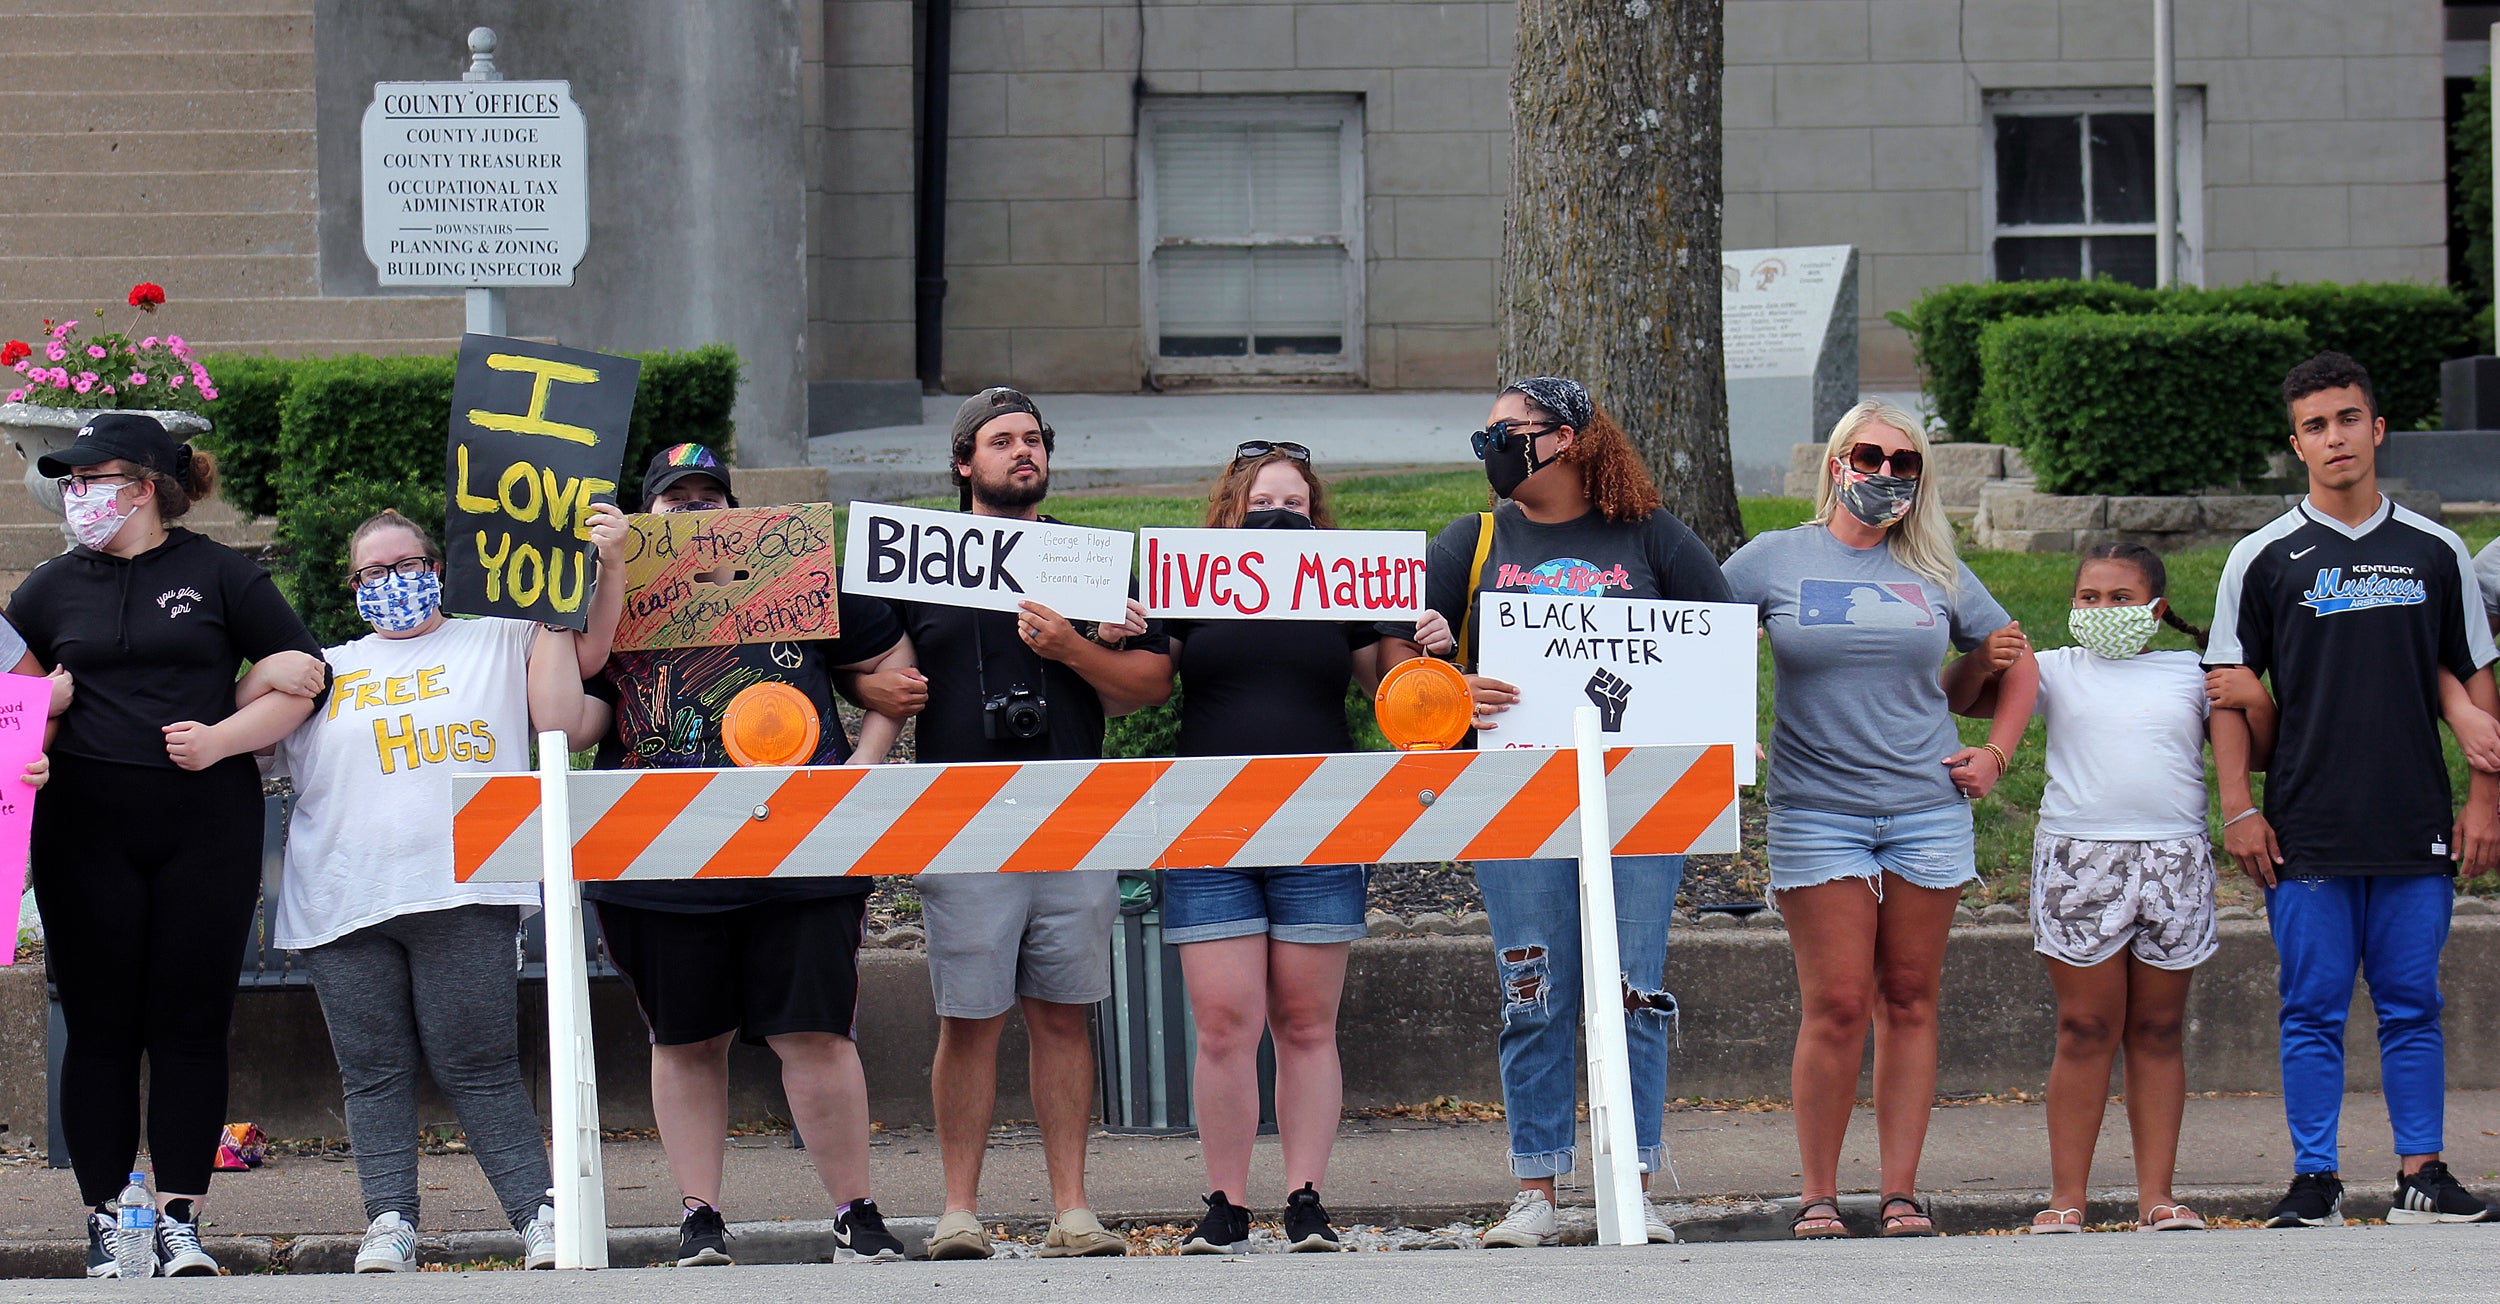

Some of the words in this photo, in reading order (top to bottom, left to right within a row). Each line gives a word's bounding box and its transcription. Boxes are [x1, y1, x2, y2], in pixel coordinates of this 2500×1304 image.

[384, 94, 467, 114] COUNTY
[475, 94, 559, 113] OFFICES
[406, 129, 477, 143] COUNTY
[481, 129, 538, 143] JUDGE
[383, 154, 453, 168] COUNTY
[458, 154, 562, 168] TREASURER
[388, 180, 520, 194] OCCUPATIONAL
[524, 181, 558, 194] TAX
[402, 199, 545, 212] ADMINISTRATOR
[435, 224, 513, 235] DOWNSTAIRS
[390, 240, 473, 254] PLANNING
[478, 241, 490, 254] &
[495, 240, 559, 254] ZONING
[388, 262, 465, 276] BUILDING
[471, 262, 562, 276] INSPECTOR
[466, 353, 600, 447] I
[456, 443, 616, 542] LOVE
[692, 520, 746, 559] the
[1044, 531, 1079, 549] George
[1087, 533, 1111, 550] Floyd
[1042, 552, 1080, 563] Ahmaud
[1086, 551, 1113, 567] Arbery
[476, 529, 584, 613] YOU
[1149, 538, 1270, 615] lives
[1291, 552, 1427, 611] Matter
[1496, 563, 1561, 589] Hard
[1566, 563, 1633, 593] Rock
[2352, 564, 2414, 575] KENTUCKY
[1040, 571, 1078, 584] Breanna
[1083, 574, 1111, 588] Taylor
[2304, 567, 2425, 605] Mustangs
[156, 589, 176, 608] you
[625, 577, 693, 620] Teach
[2349, 597, 2395, 608] ARSENAL
[171, 602, 191, 618] girl
[1499, 601, 1598, 633] BLACK
[1627, 605, 1711, 636] LIVES
[1544, 638, 1662, 665] MATTER
[327, 664, 449, 722] FREE
[372, 713, 496, 775] HUGS
